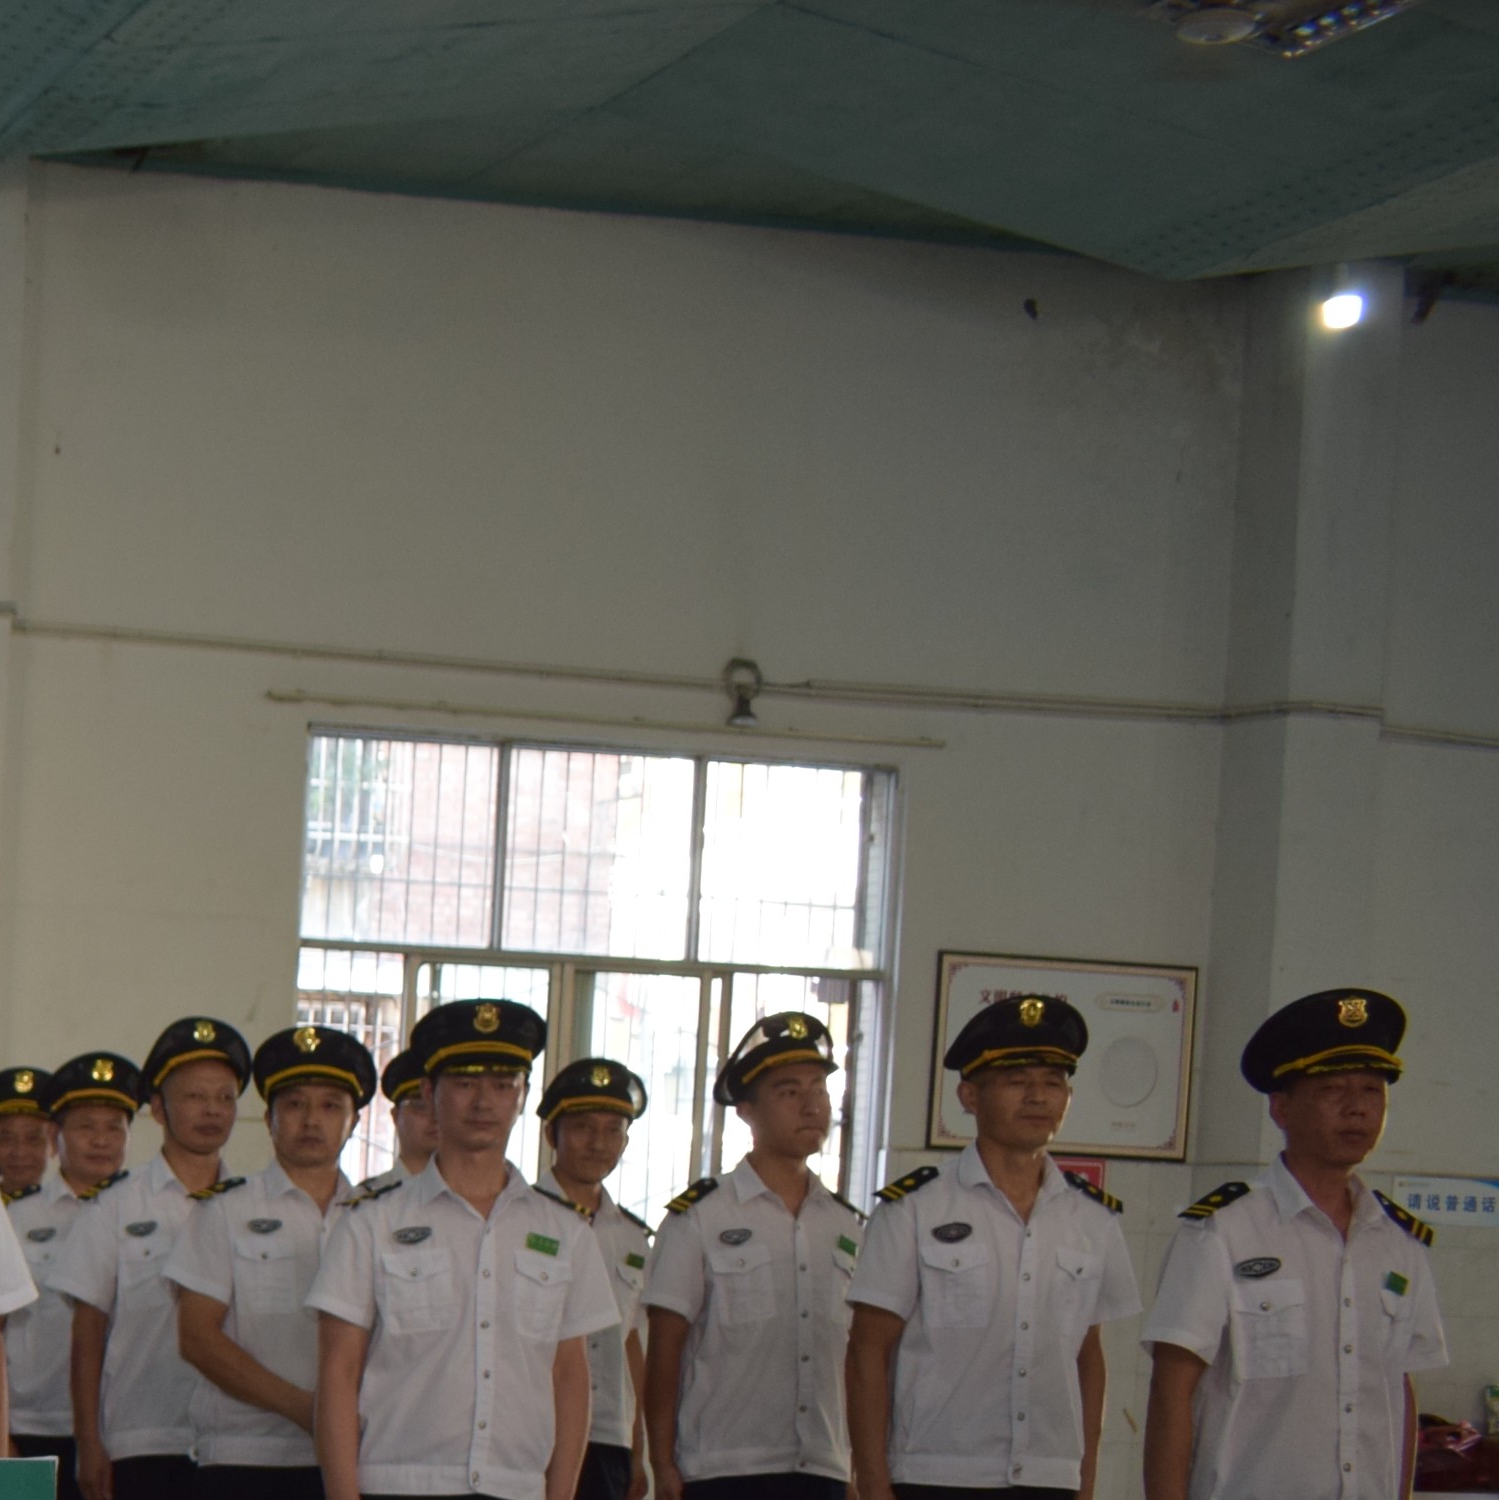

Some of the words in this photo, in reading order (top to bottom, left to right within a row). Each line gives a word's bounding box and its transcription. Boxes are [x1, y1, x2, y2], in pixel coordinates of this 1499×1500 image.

[1407, 1192, 1496, 1213] 请说普通话
